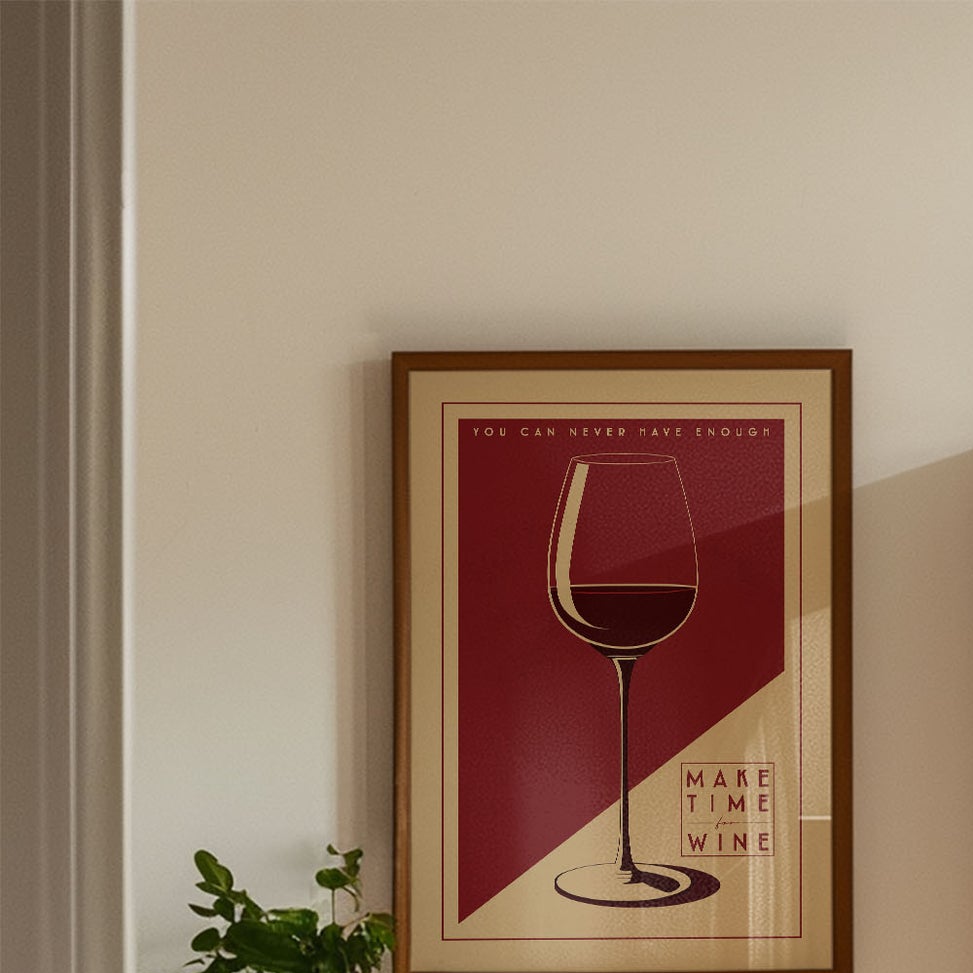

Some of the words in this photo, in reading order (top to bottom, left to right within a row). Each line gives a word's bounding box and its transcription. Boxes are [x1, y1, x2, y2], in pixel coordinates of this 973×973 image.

[473, 427, 506, 437] YOU
[520, 427, 555, 437] CAN
[569, 427, 626, 437] NEVER
[639, 427, 682, 437] HAVE
[695, 427, 770, 437] ENOUGH
[686, 769, 770, 788] MAKE
[686, 794, 769, 813] TIME
[687, 832, 769, 852] WINE
